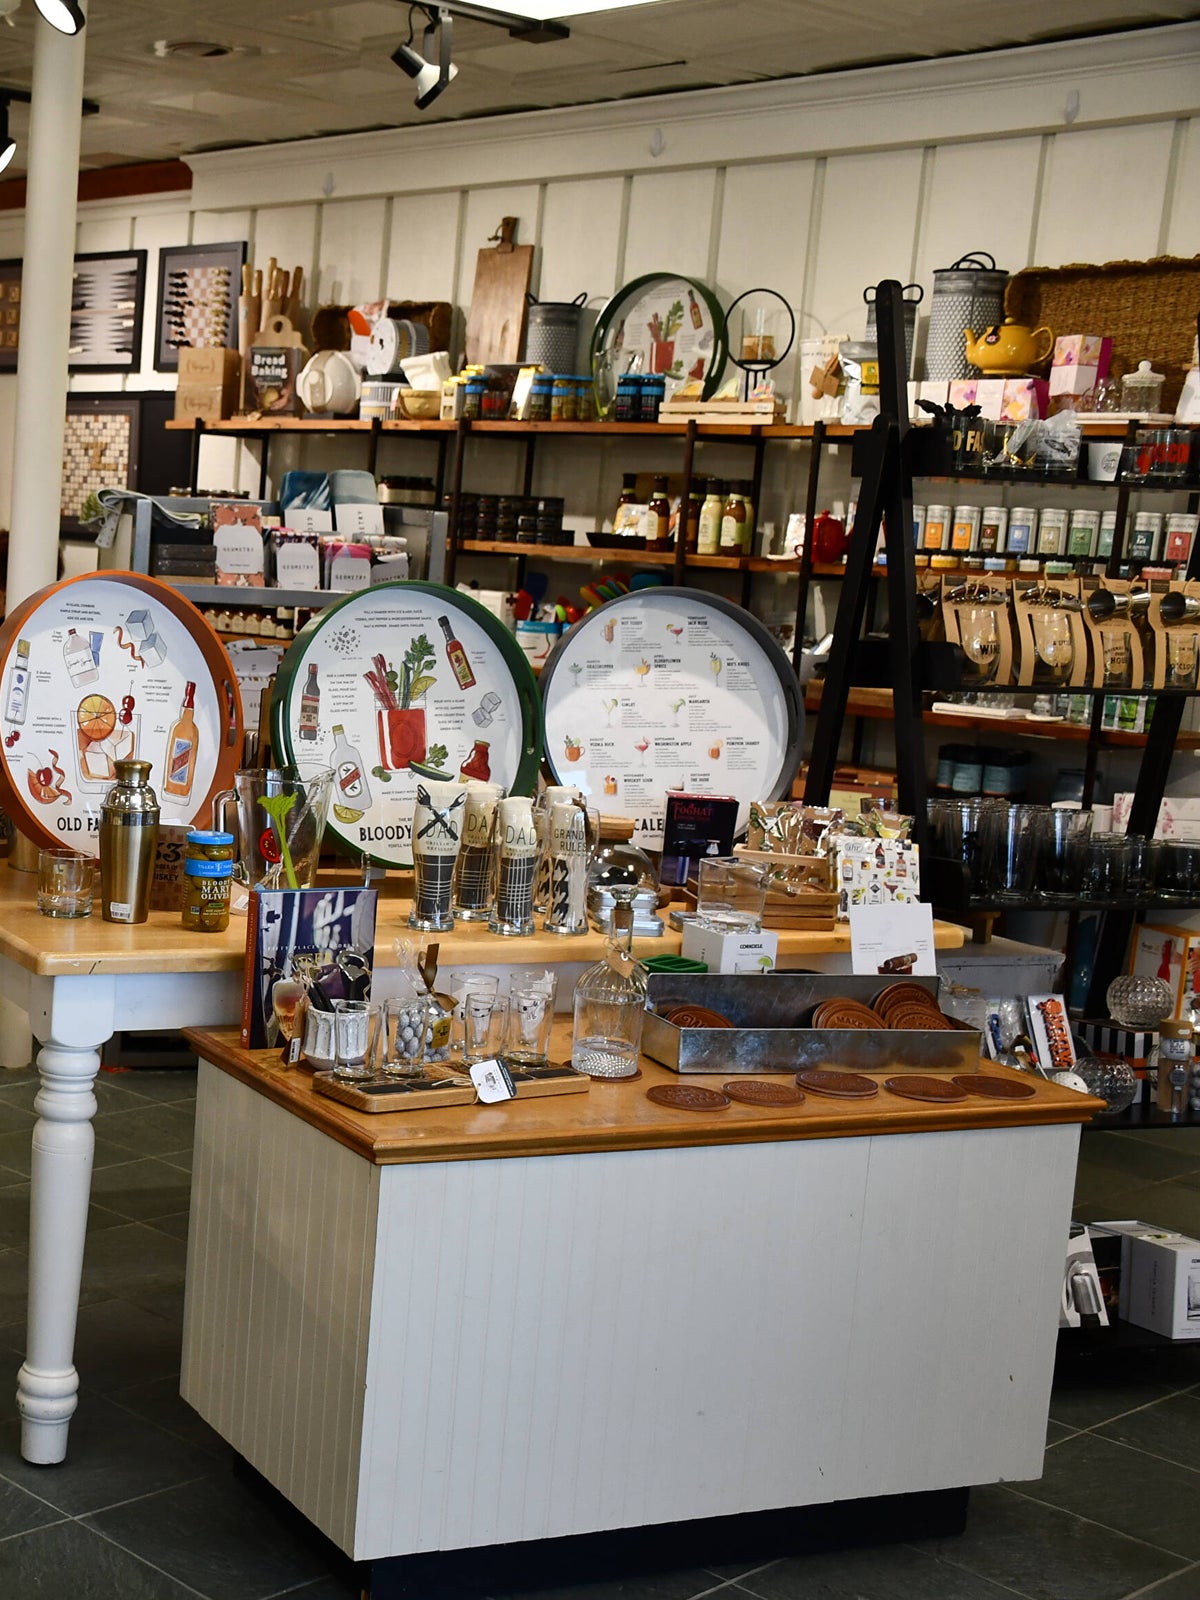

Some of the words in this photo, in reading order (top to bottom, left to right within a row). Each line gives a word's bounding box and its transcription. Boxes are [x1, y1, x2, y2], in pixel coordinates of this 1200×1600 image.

[254, 354, 286, 365] Bread
[251, 365, 288, 379] Baking
[57, 817, 82, 831] OLD
[426, 819, 458, 838] DAD
[468, 813, 488, 832] DA
[634, 818, 664, 832] CALE
[360, 826, 412, 842] BLOODY
[506, 825, 537, 846] DAD
[554, 828, 584, 840] GRAND
[560, 840, 588, 852] RULES
[154, 873, 179, 881] ISKEY
